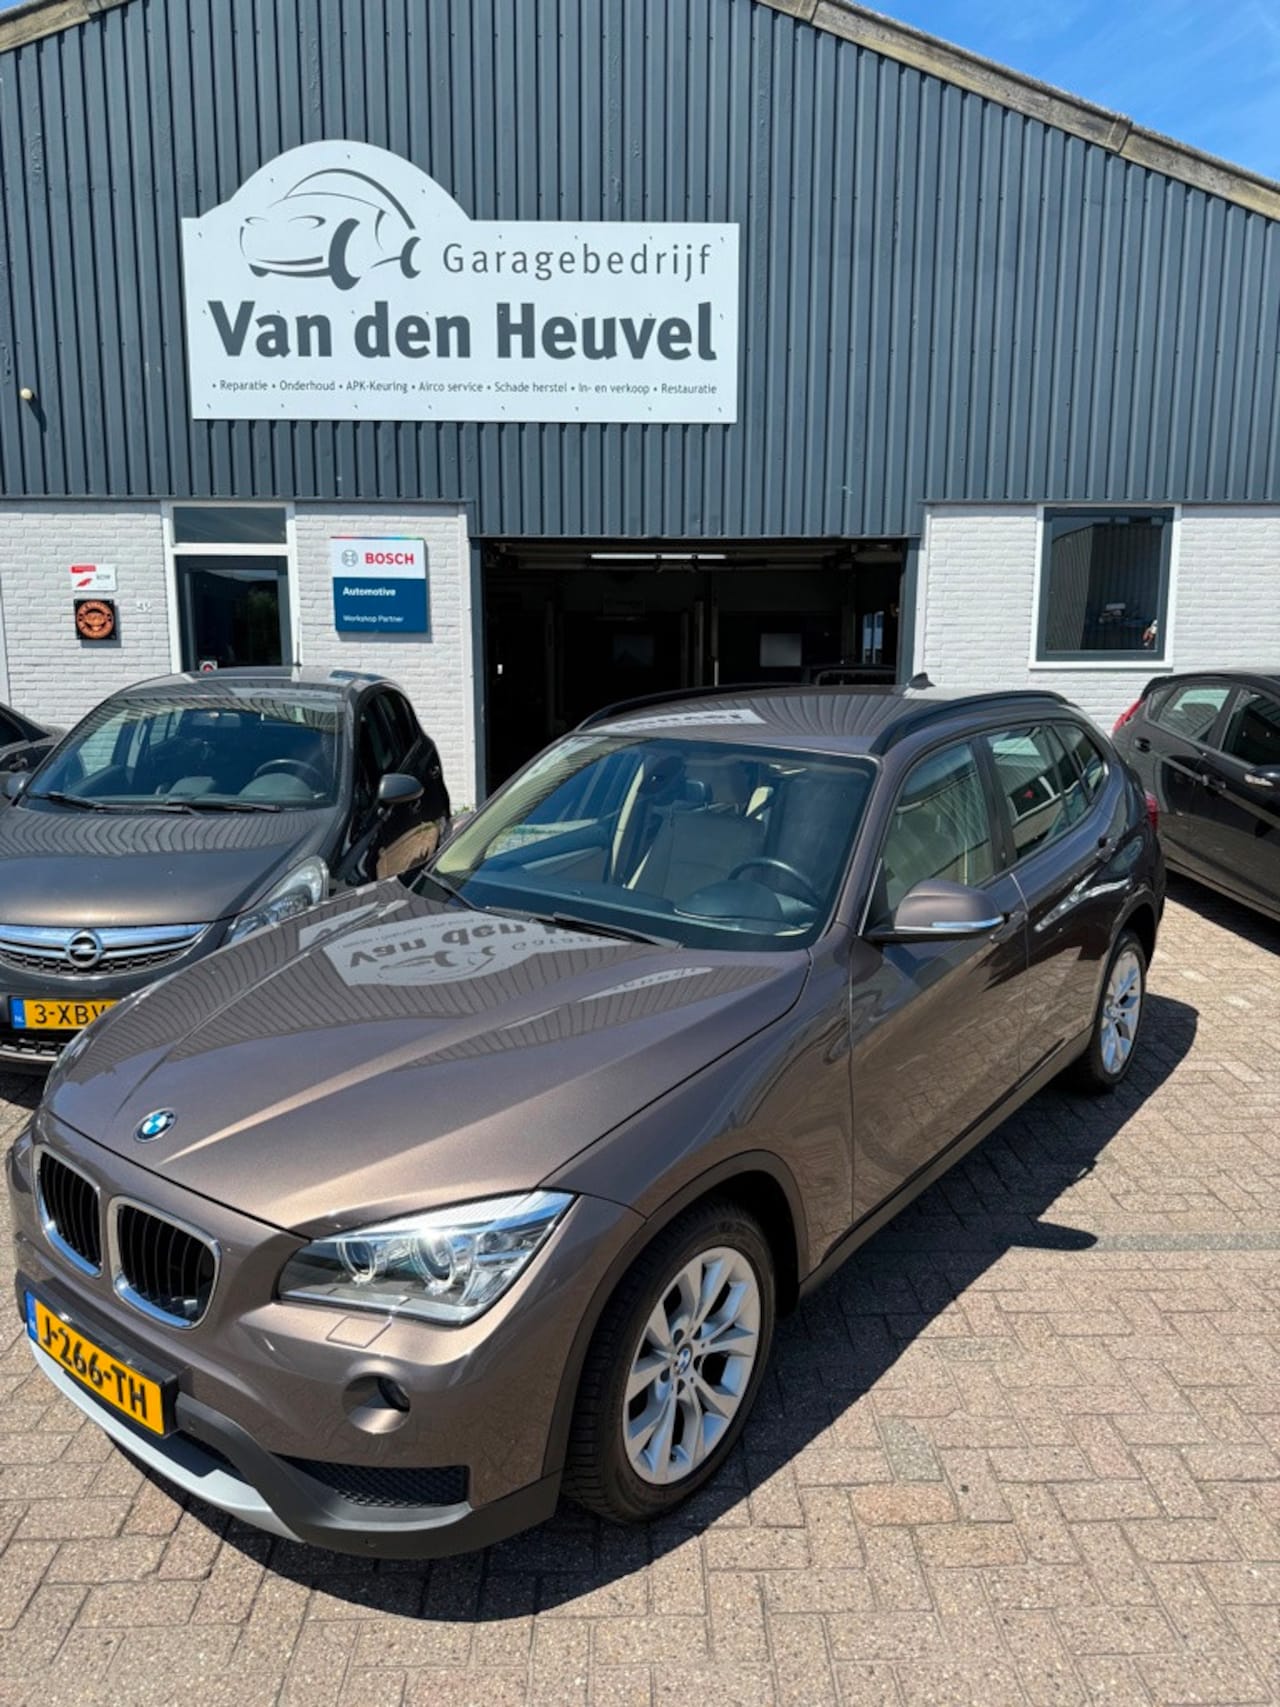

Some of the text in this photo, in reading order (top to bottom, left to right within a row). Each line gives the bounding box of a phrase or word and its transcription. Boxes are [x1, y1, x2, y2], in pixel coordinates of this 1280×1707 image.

[443, 243, 711, 281] Garagebedrijf
[207, 300, 717, 360] Van den Heuvel
[219, 379, 717, 395] Reparatie Onderhoud APK-Keuring Airco service Schade herstel In- en verkoop Restauratie
[364, 552, 415, 566] BOSCH
[342, 587, 397, 597] Automotive
[342, 615, 377, 623] Workshop
[42, 1314, 149, 1421] J-266-TH
